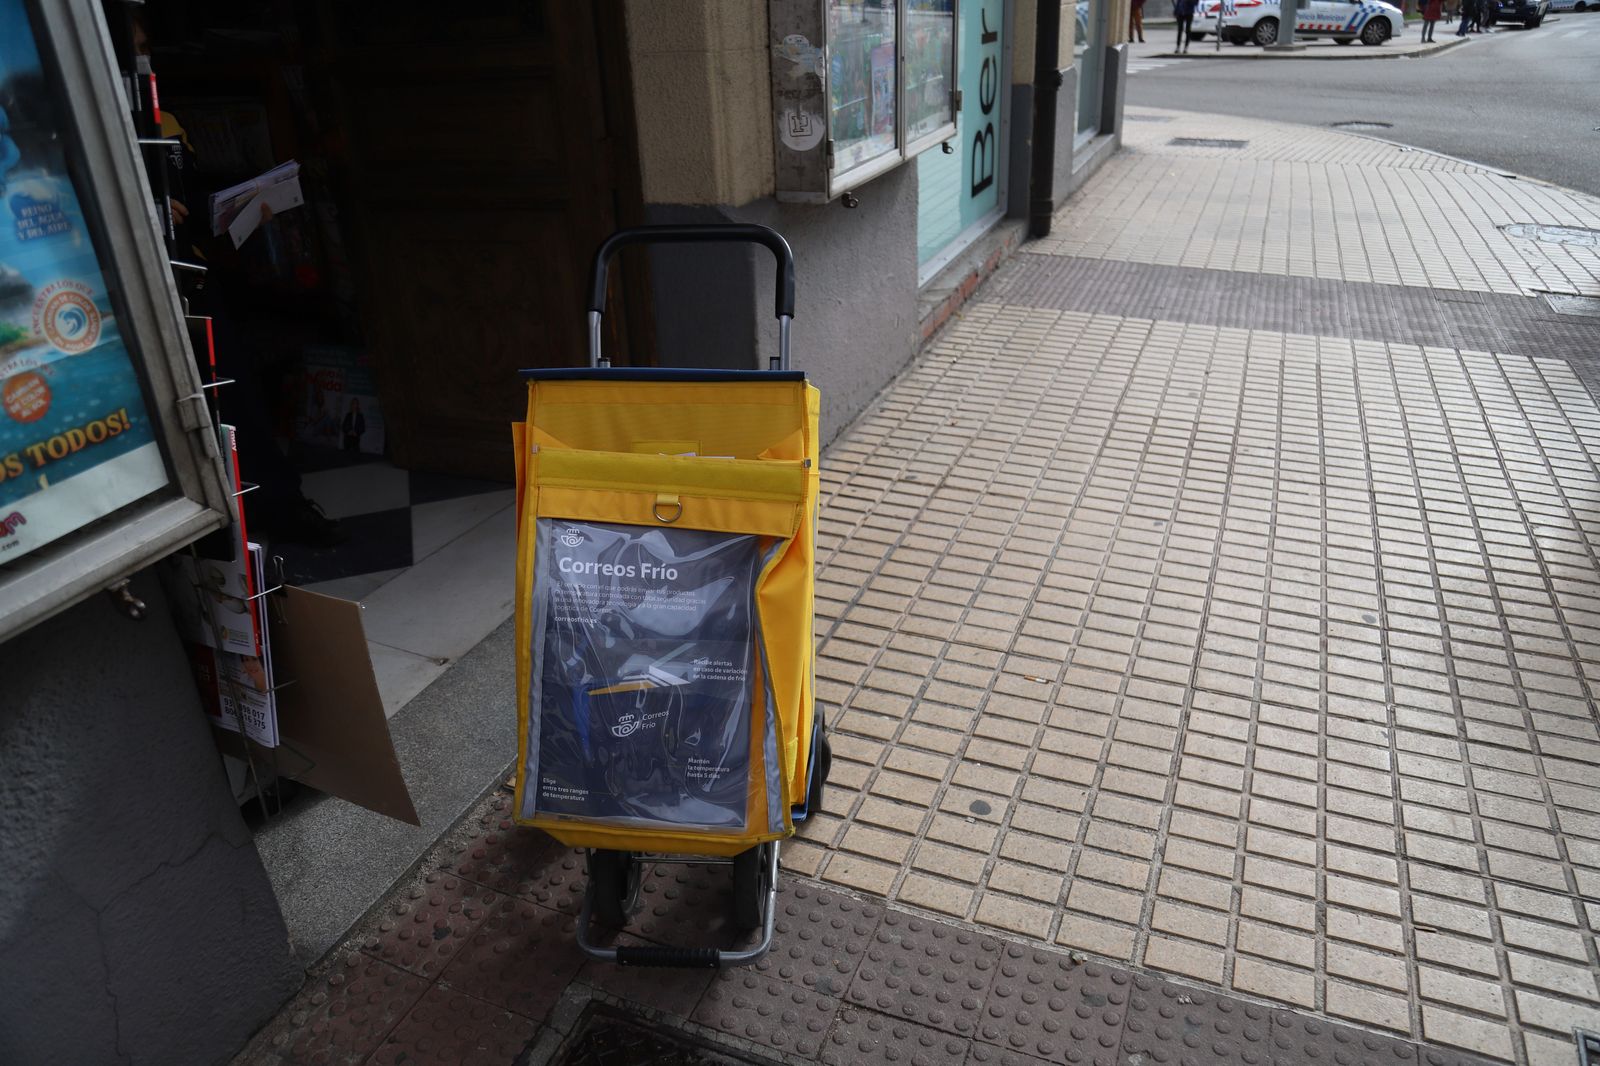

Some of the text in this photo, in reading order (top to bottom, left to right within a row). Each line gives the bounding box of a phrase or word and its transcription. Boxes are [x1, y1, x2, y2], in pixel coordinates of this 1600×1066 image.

[25, 407, 132, 468] TODOS!
[559, 556, 679, 580] Correos Frío
[642, 709, 670, 721] Correos
[694, 765, 730, 773] temperatura
[550, 792, 585, 802] temperatura
